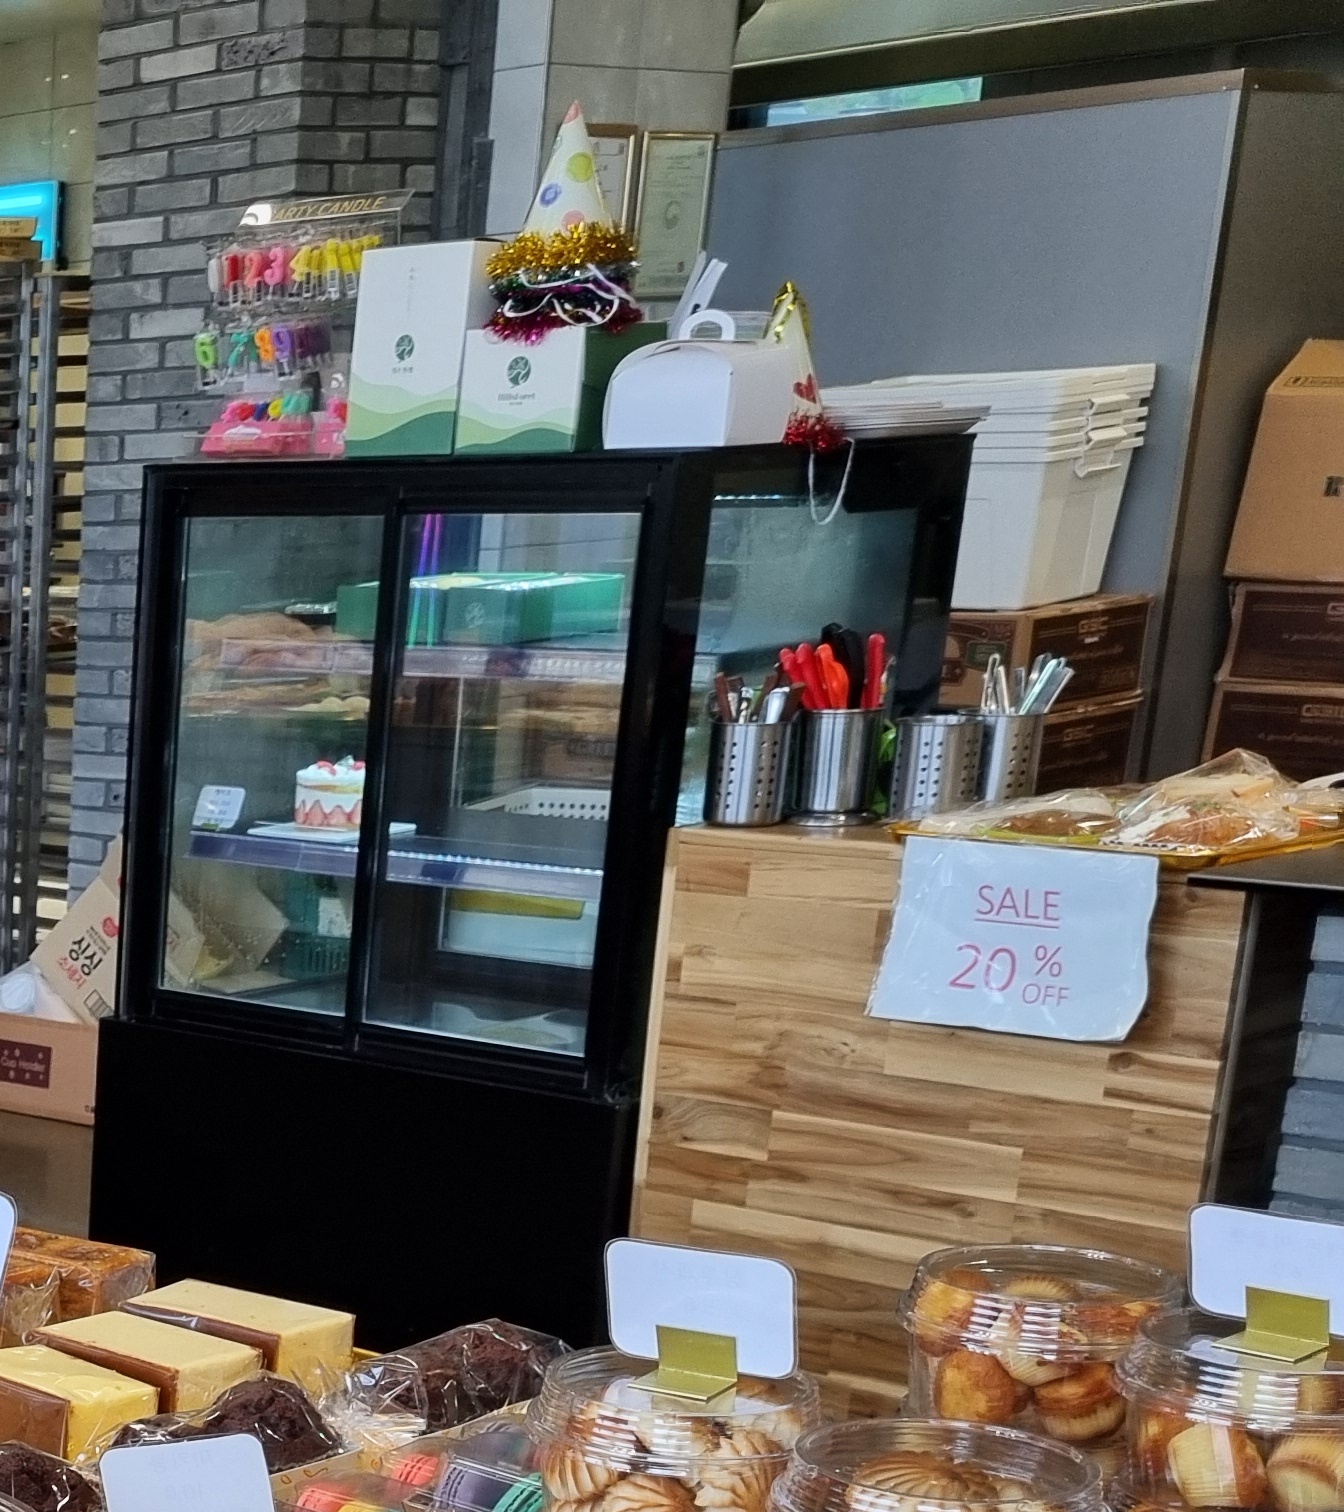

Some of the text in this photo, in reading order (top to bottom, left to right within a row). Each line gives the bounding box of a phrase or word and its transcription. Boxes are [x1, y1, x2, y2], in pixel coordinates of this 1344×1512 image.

[272, 196, 388, 221] ARTY CANDLE
[975, 884, 1062, 922] SALE
[69, 936, 103, 977] 싱싱
[948, 943, 1063, 993] 20 %
[1021, 982, 1072, 1008] OFF
